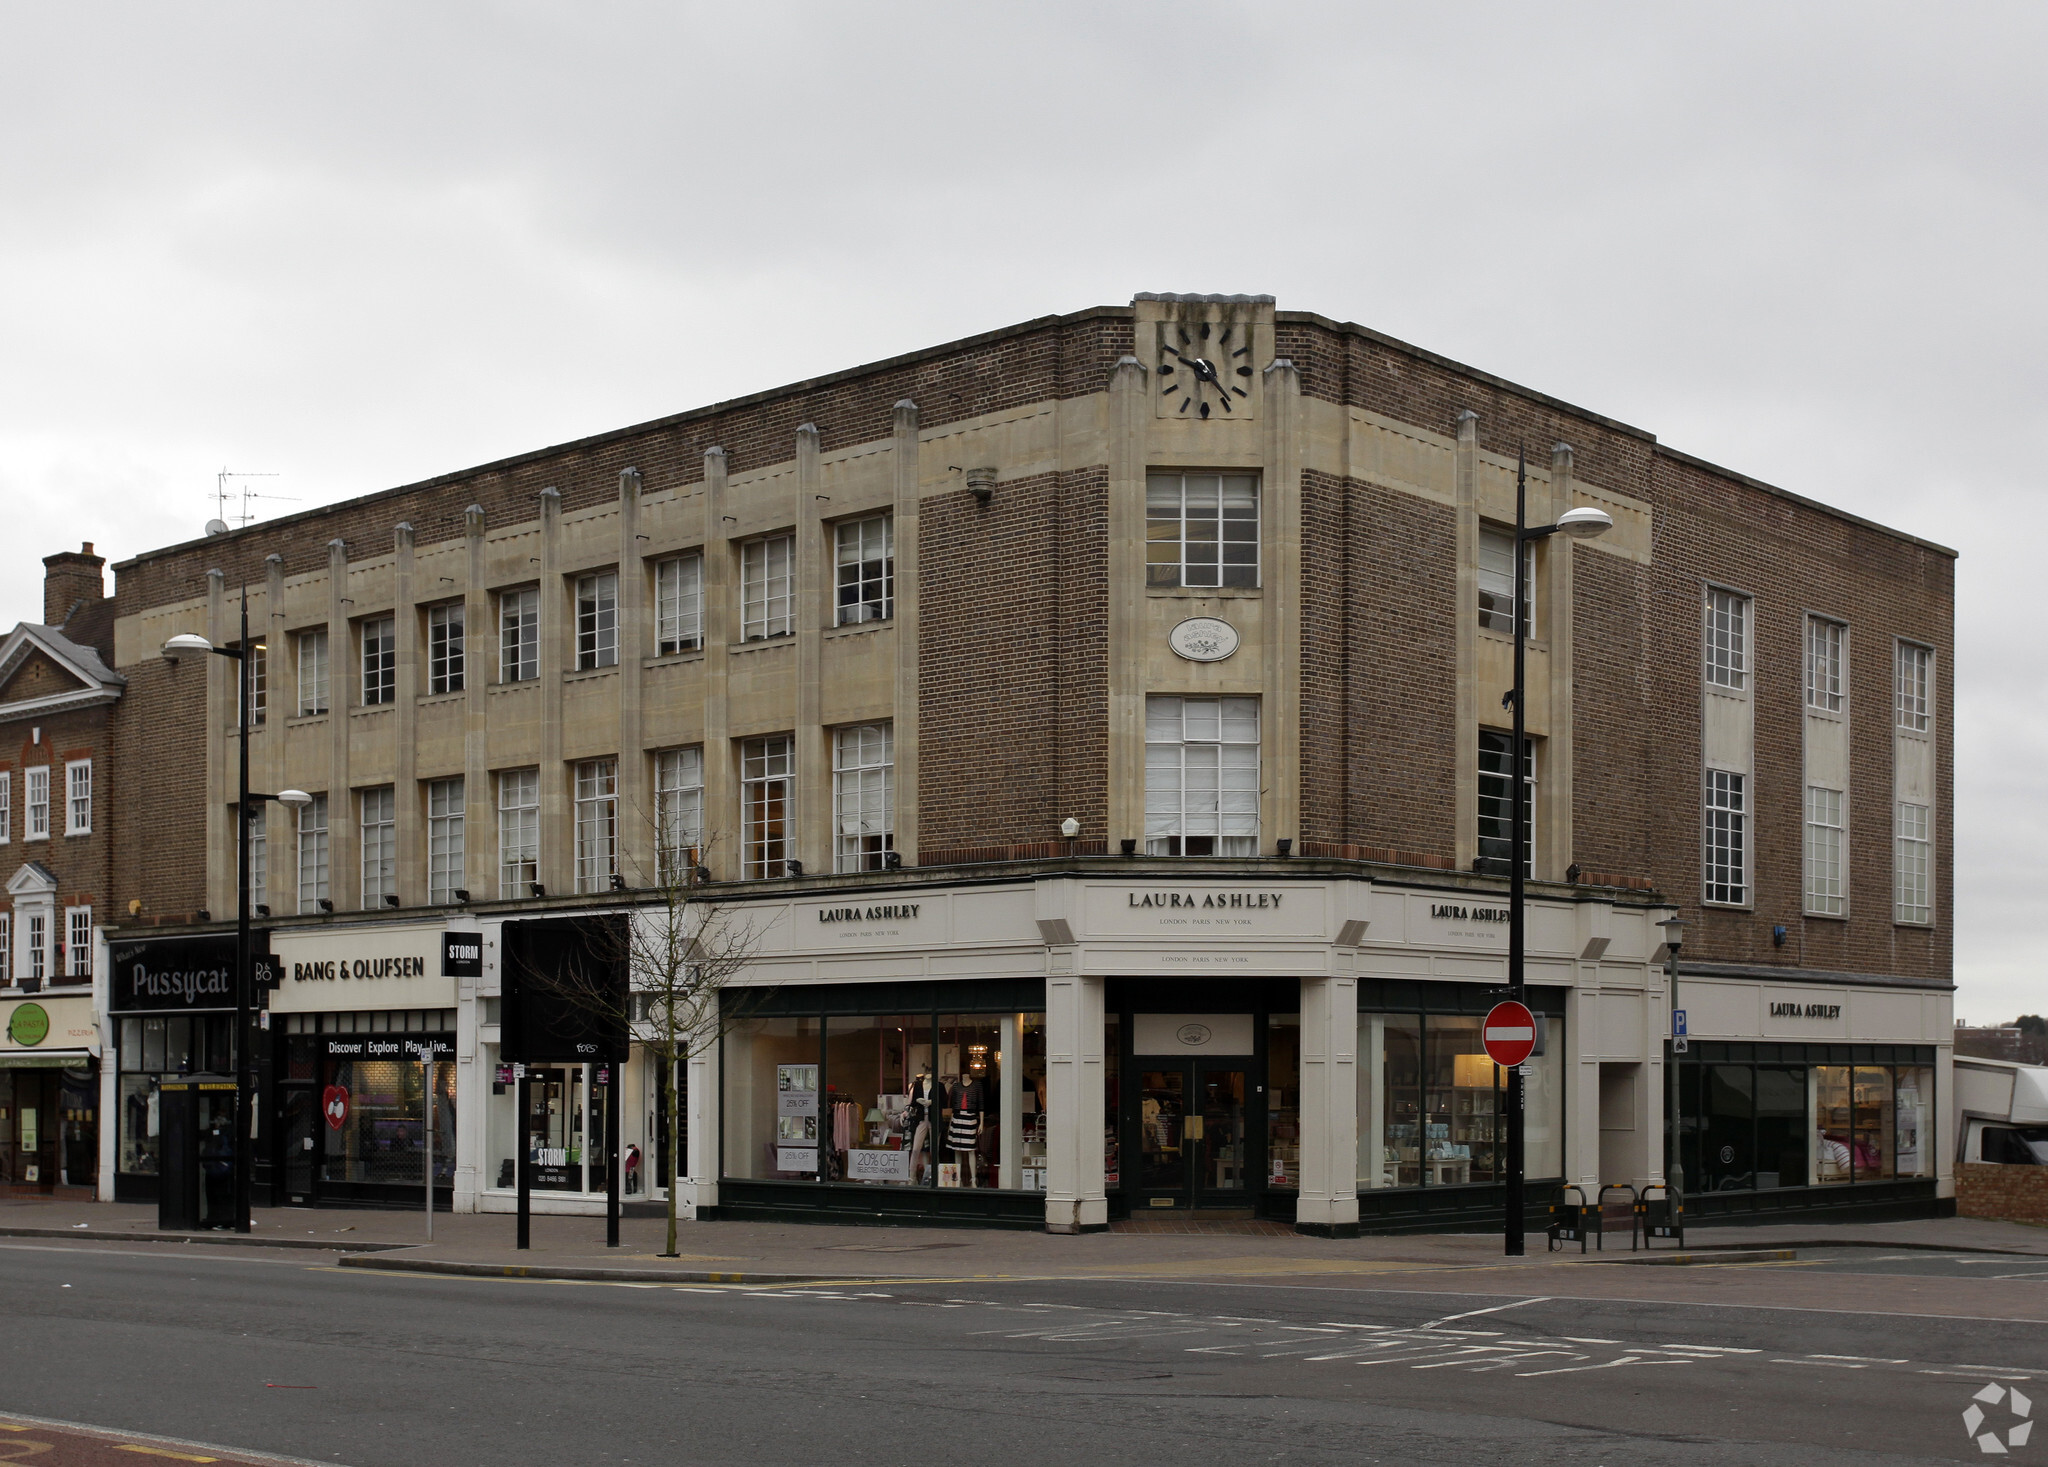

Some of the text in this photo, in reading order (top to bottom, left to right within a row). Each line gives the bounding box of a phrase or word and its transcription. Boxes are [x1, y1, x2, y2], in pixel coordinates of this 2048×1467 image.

[1129, 893, 1283, 909] LAURA ASHLEY
[819, 904, 920, 923] LAURA ASHLEY
[1432, 904, 1468, 919] LAURA
[449, 945, 478, 959] STORM
[294, 956, 423, 981] BANG & OLUFSEN
[132, 963, 229, 1004] Pussycat
[1770, 1002, 1841, 1019] LAURA ASHLEY
[1675, 1012, 1685, 1033] P
[328, 1041, 362, 1053] Discover
[368, 1040, 399, 1056] Explore
[405, 1040, 423, 1056] Play
[538, 1148, 566, 1166] STORM
[857, 1152, 899, 1167] 20% OFF
